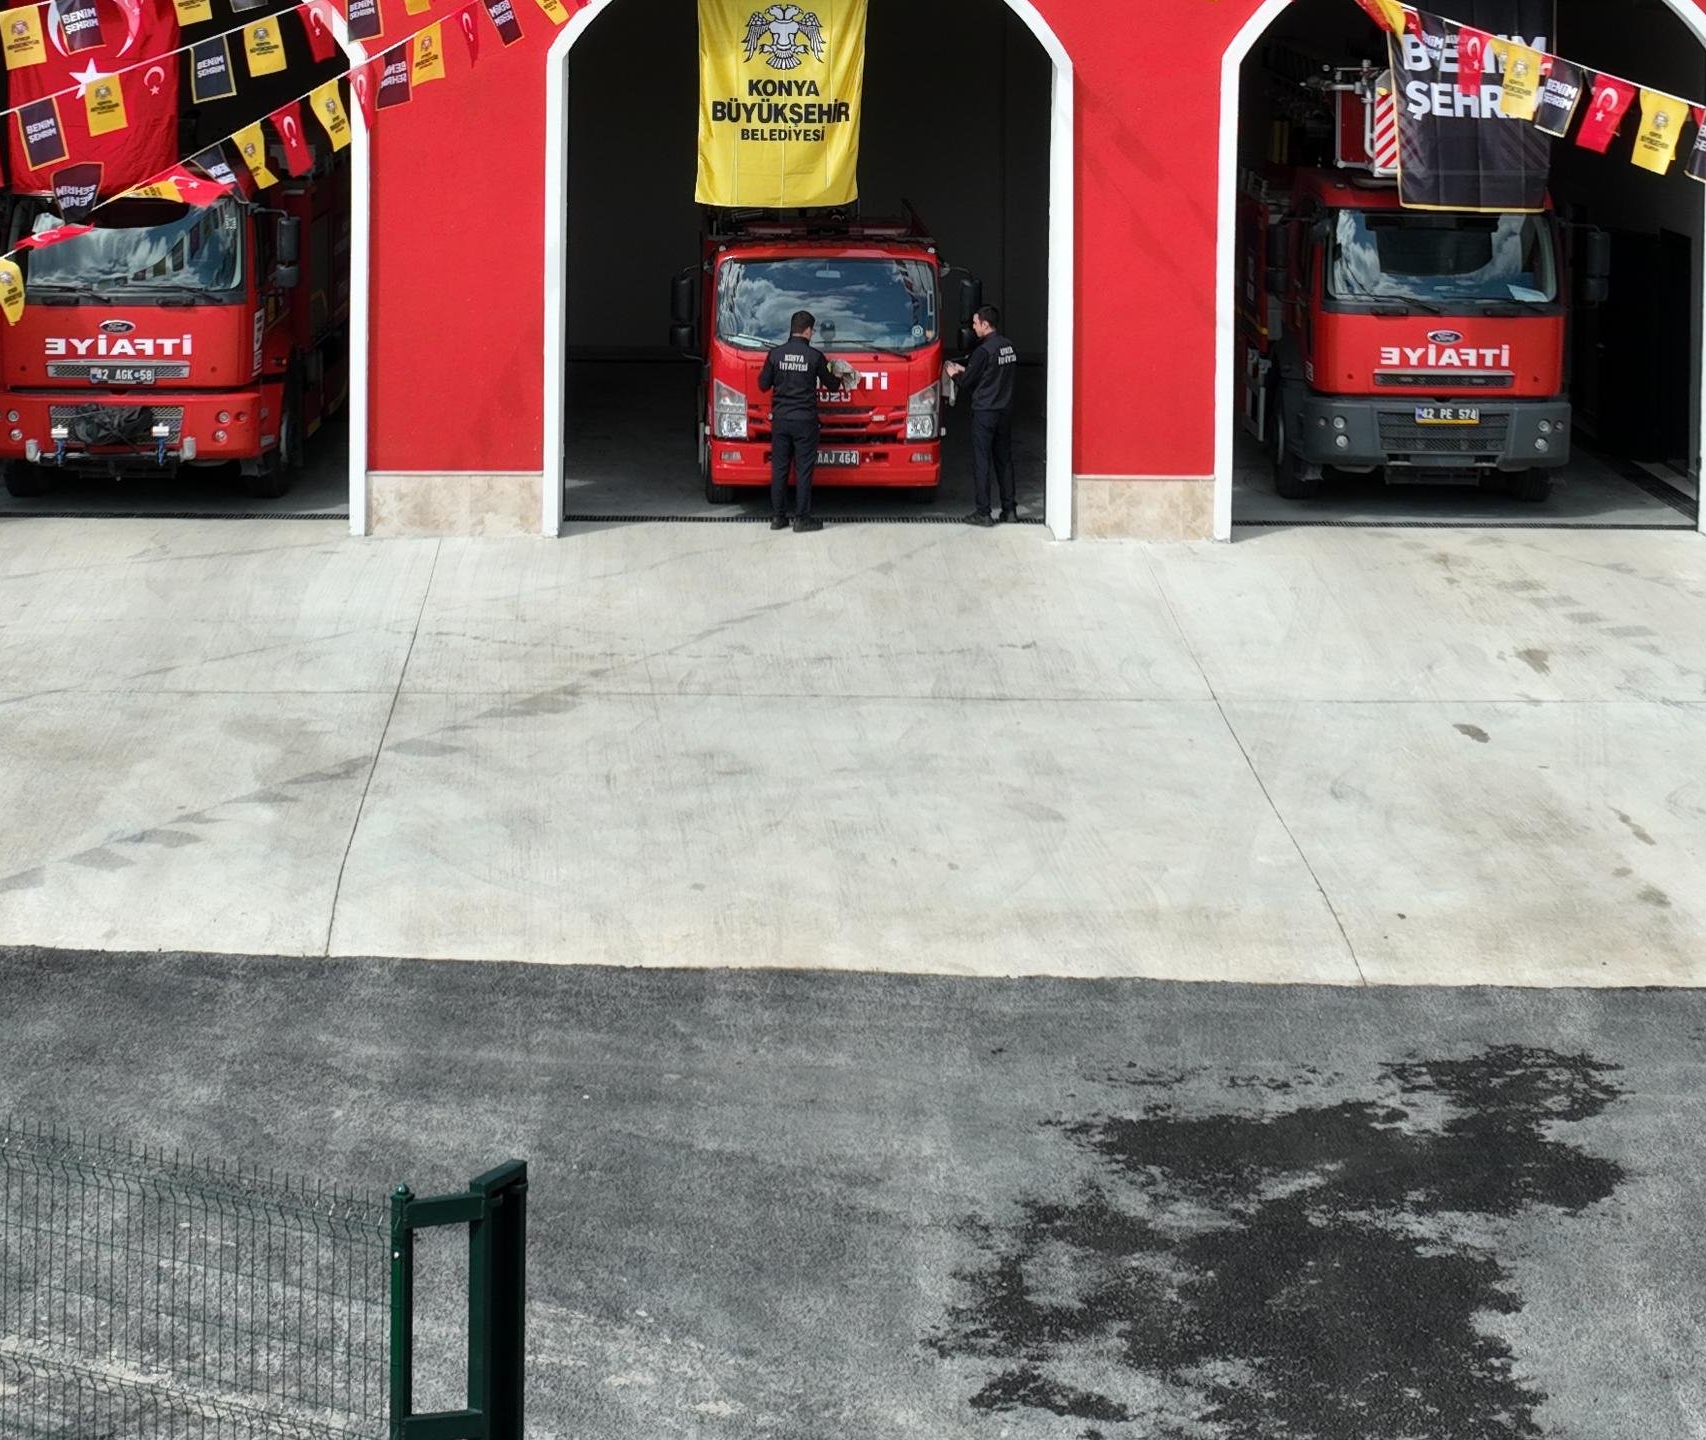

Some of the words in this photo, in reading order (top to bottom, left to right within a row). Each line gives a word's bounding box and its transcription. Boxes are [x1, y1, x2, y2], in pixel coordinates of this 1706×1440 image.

[61, 7, 96, 24] BENİM
[748, 79, 820, 97] KONYA
[711, 98, 850, 127] BÜYÜKŞEHİR
[740, 126, 825, 141] BELEDİYESİ
[115, 369, 133, 380] AGK
[140, 369, 153, 381] 58
[816, 391, 852, 402] UZU
[1440, 409, 1453, 419] PE
[839, 452, 857, 464] 464
